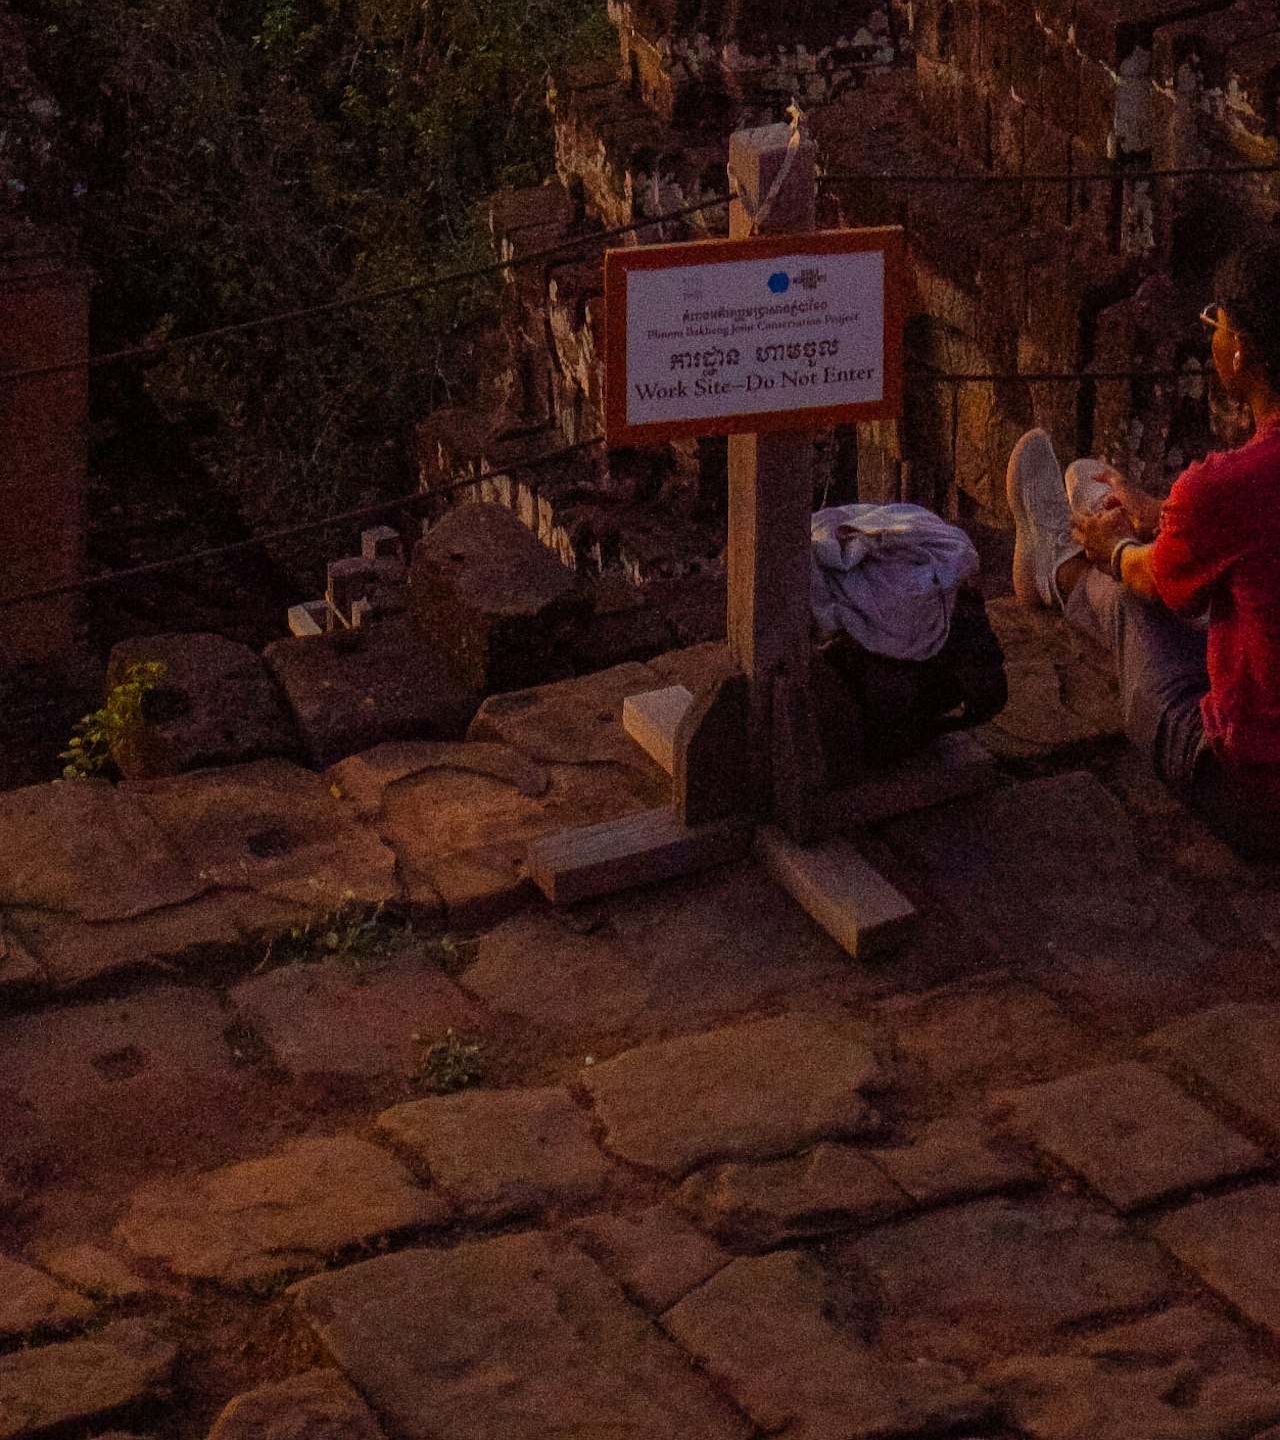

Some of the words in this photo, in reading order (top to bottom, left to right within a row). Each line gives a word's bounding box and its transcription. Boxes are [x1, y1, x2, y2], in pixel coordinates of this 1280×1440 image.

[756, 316, 822, 331] Conservation
[824, 311, 859, 326] Project
[634, 380, 688, 400] Work
[781, 370, 818, 388] Not
[823, 366, 875, 384] Enter
